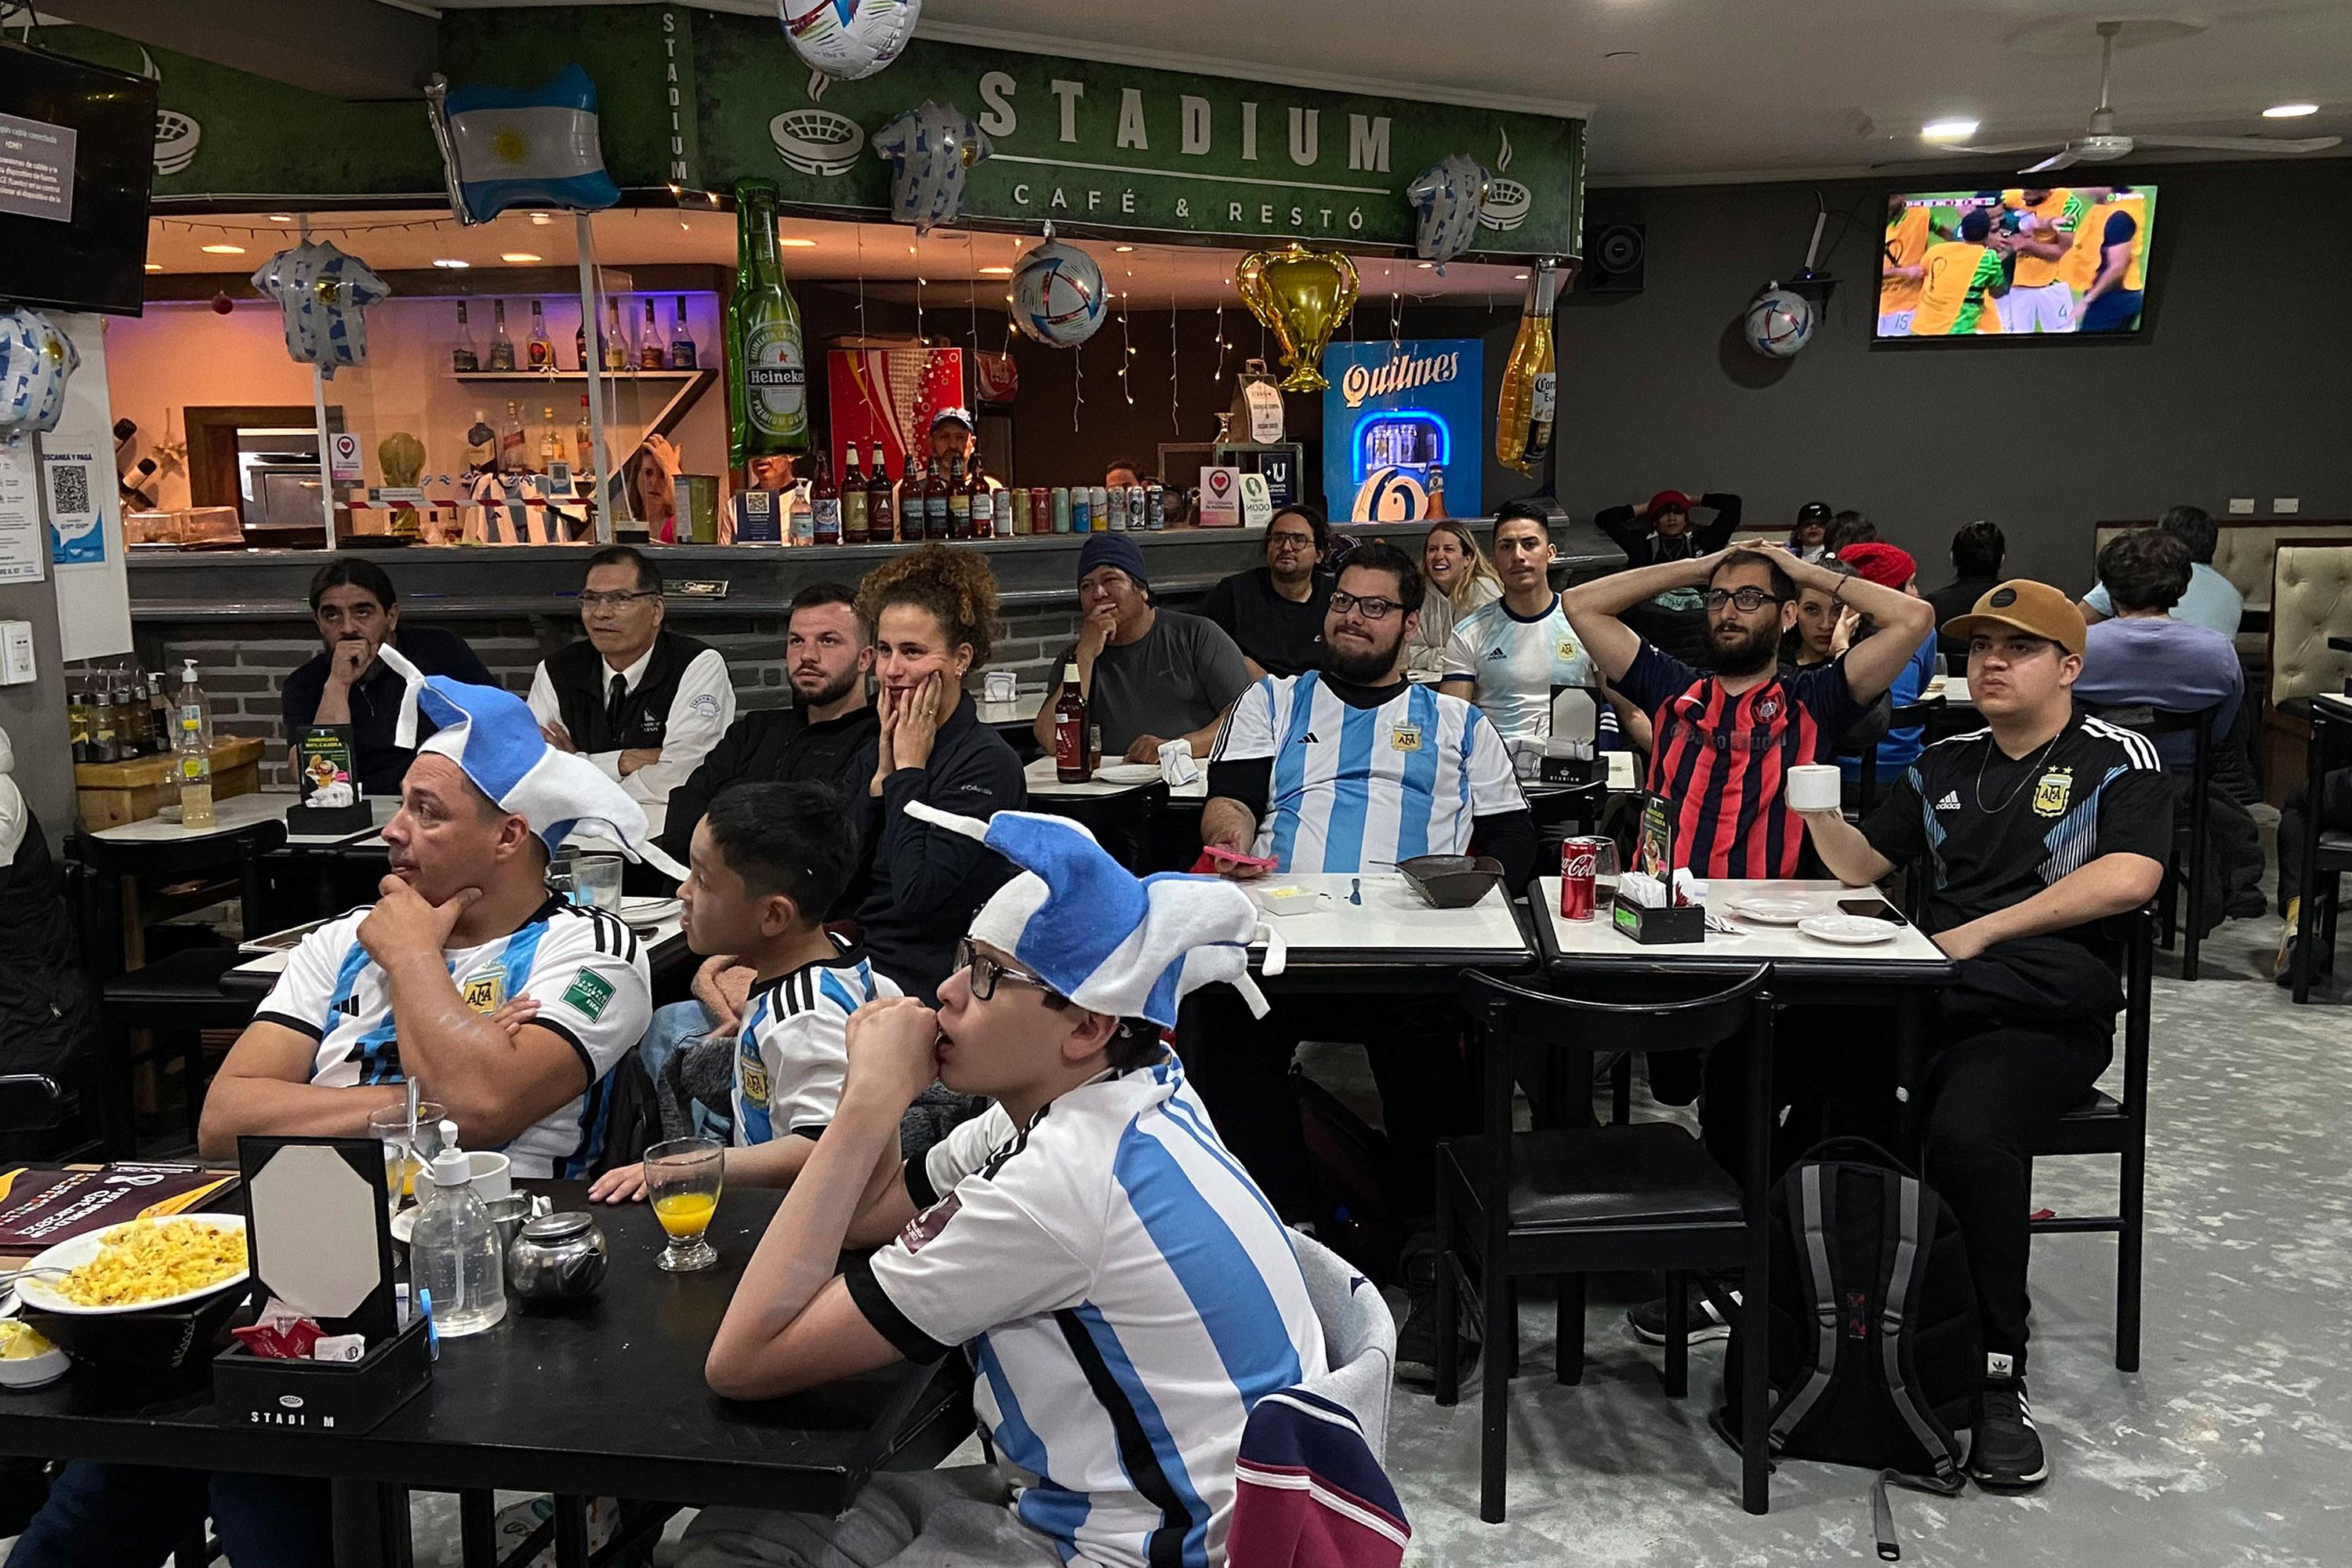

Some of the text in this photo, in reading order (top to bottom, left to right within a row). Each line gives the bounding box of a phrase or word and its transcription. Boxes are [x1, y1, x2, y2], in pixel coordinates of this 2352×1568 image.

[662, 13, 688, 180] STADIUM
[977, 70, 1391, 173] STADIUM
[1014, 183, 1363, 230] CAFÉ & RESTÓ
[1342, 351, 1459, 408] Quilmes
[1399, 733, 1416, 746] AFA
[2040, 784, 2061, 804] AFA
[1936, 802, 1962, 811] adidas
[466, 982, 493, 1007] AFA
[586, 999, 601, 1013] FIFA
[251, 1411, 335, 1428] STADIM
